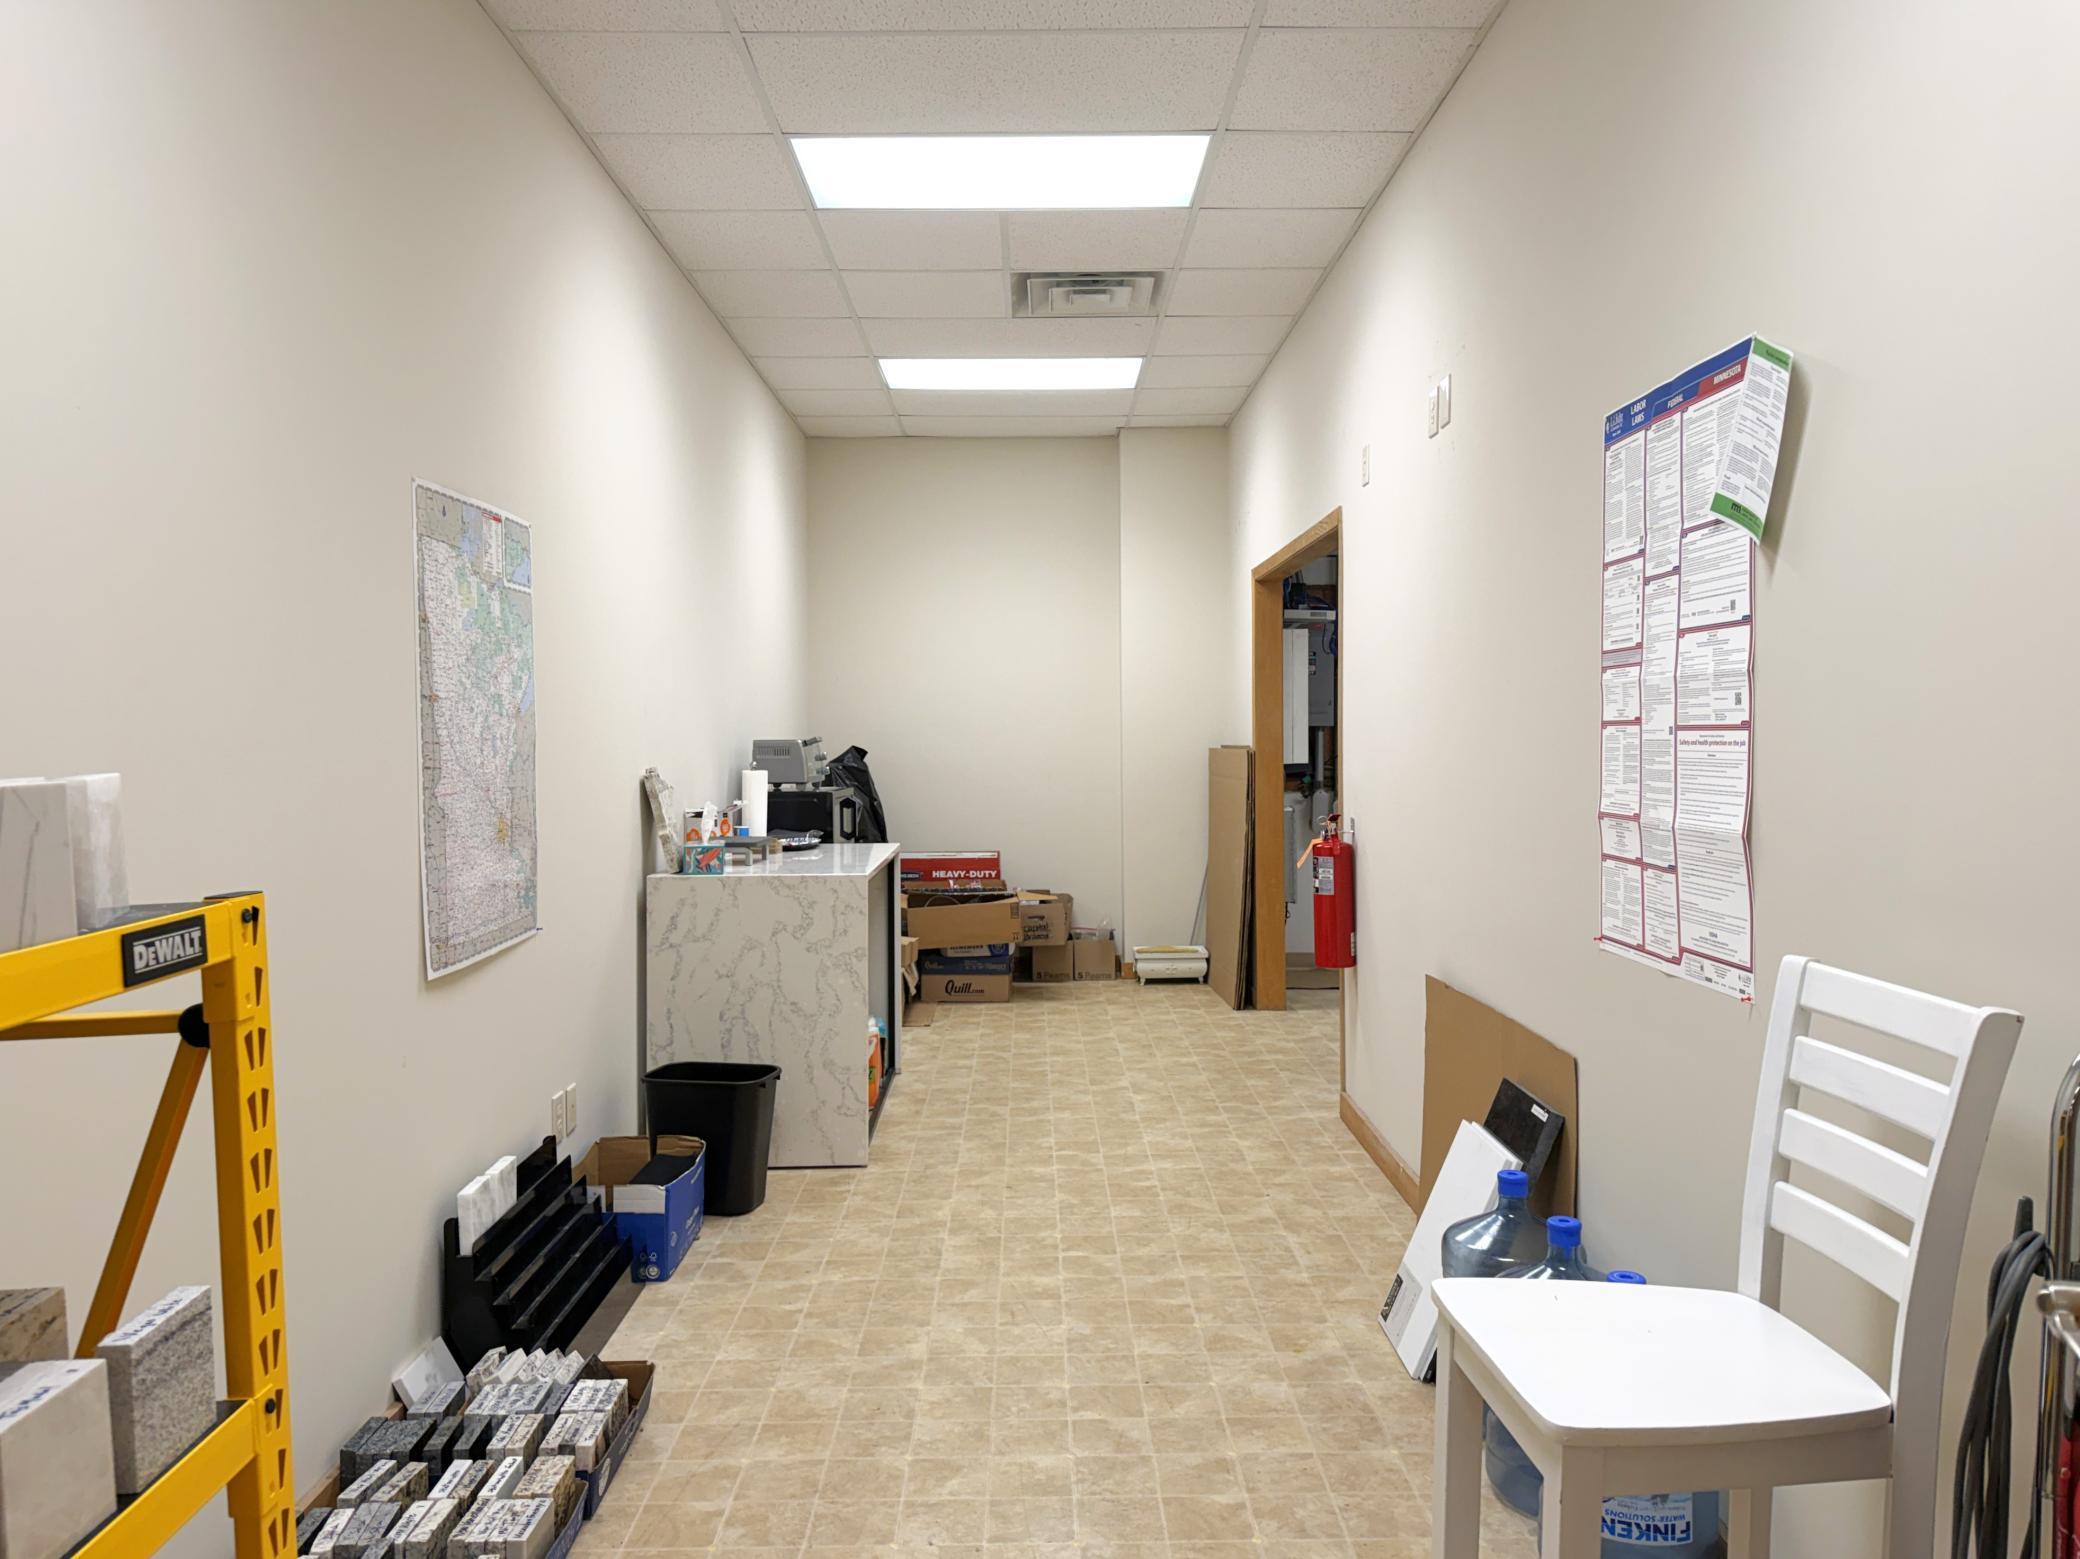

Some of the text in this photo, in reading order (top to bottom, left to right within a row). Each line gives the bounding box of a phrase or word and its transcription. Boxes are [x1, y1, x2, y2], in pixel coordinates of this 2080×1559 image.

[1630, 399, 1647, 415] LABOR
[1631, 412, 1645, 426] LAWS
[932, 870, 997, 878] HEAVY-DUTY
[1077, 971, 1083, 979] 5
[1604, 1508, 1656, 1523] SOLUTIONS
[1600, 1516, 1691, 1542] FINKEN
